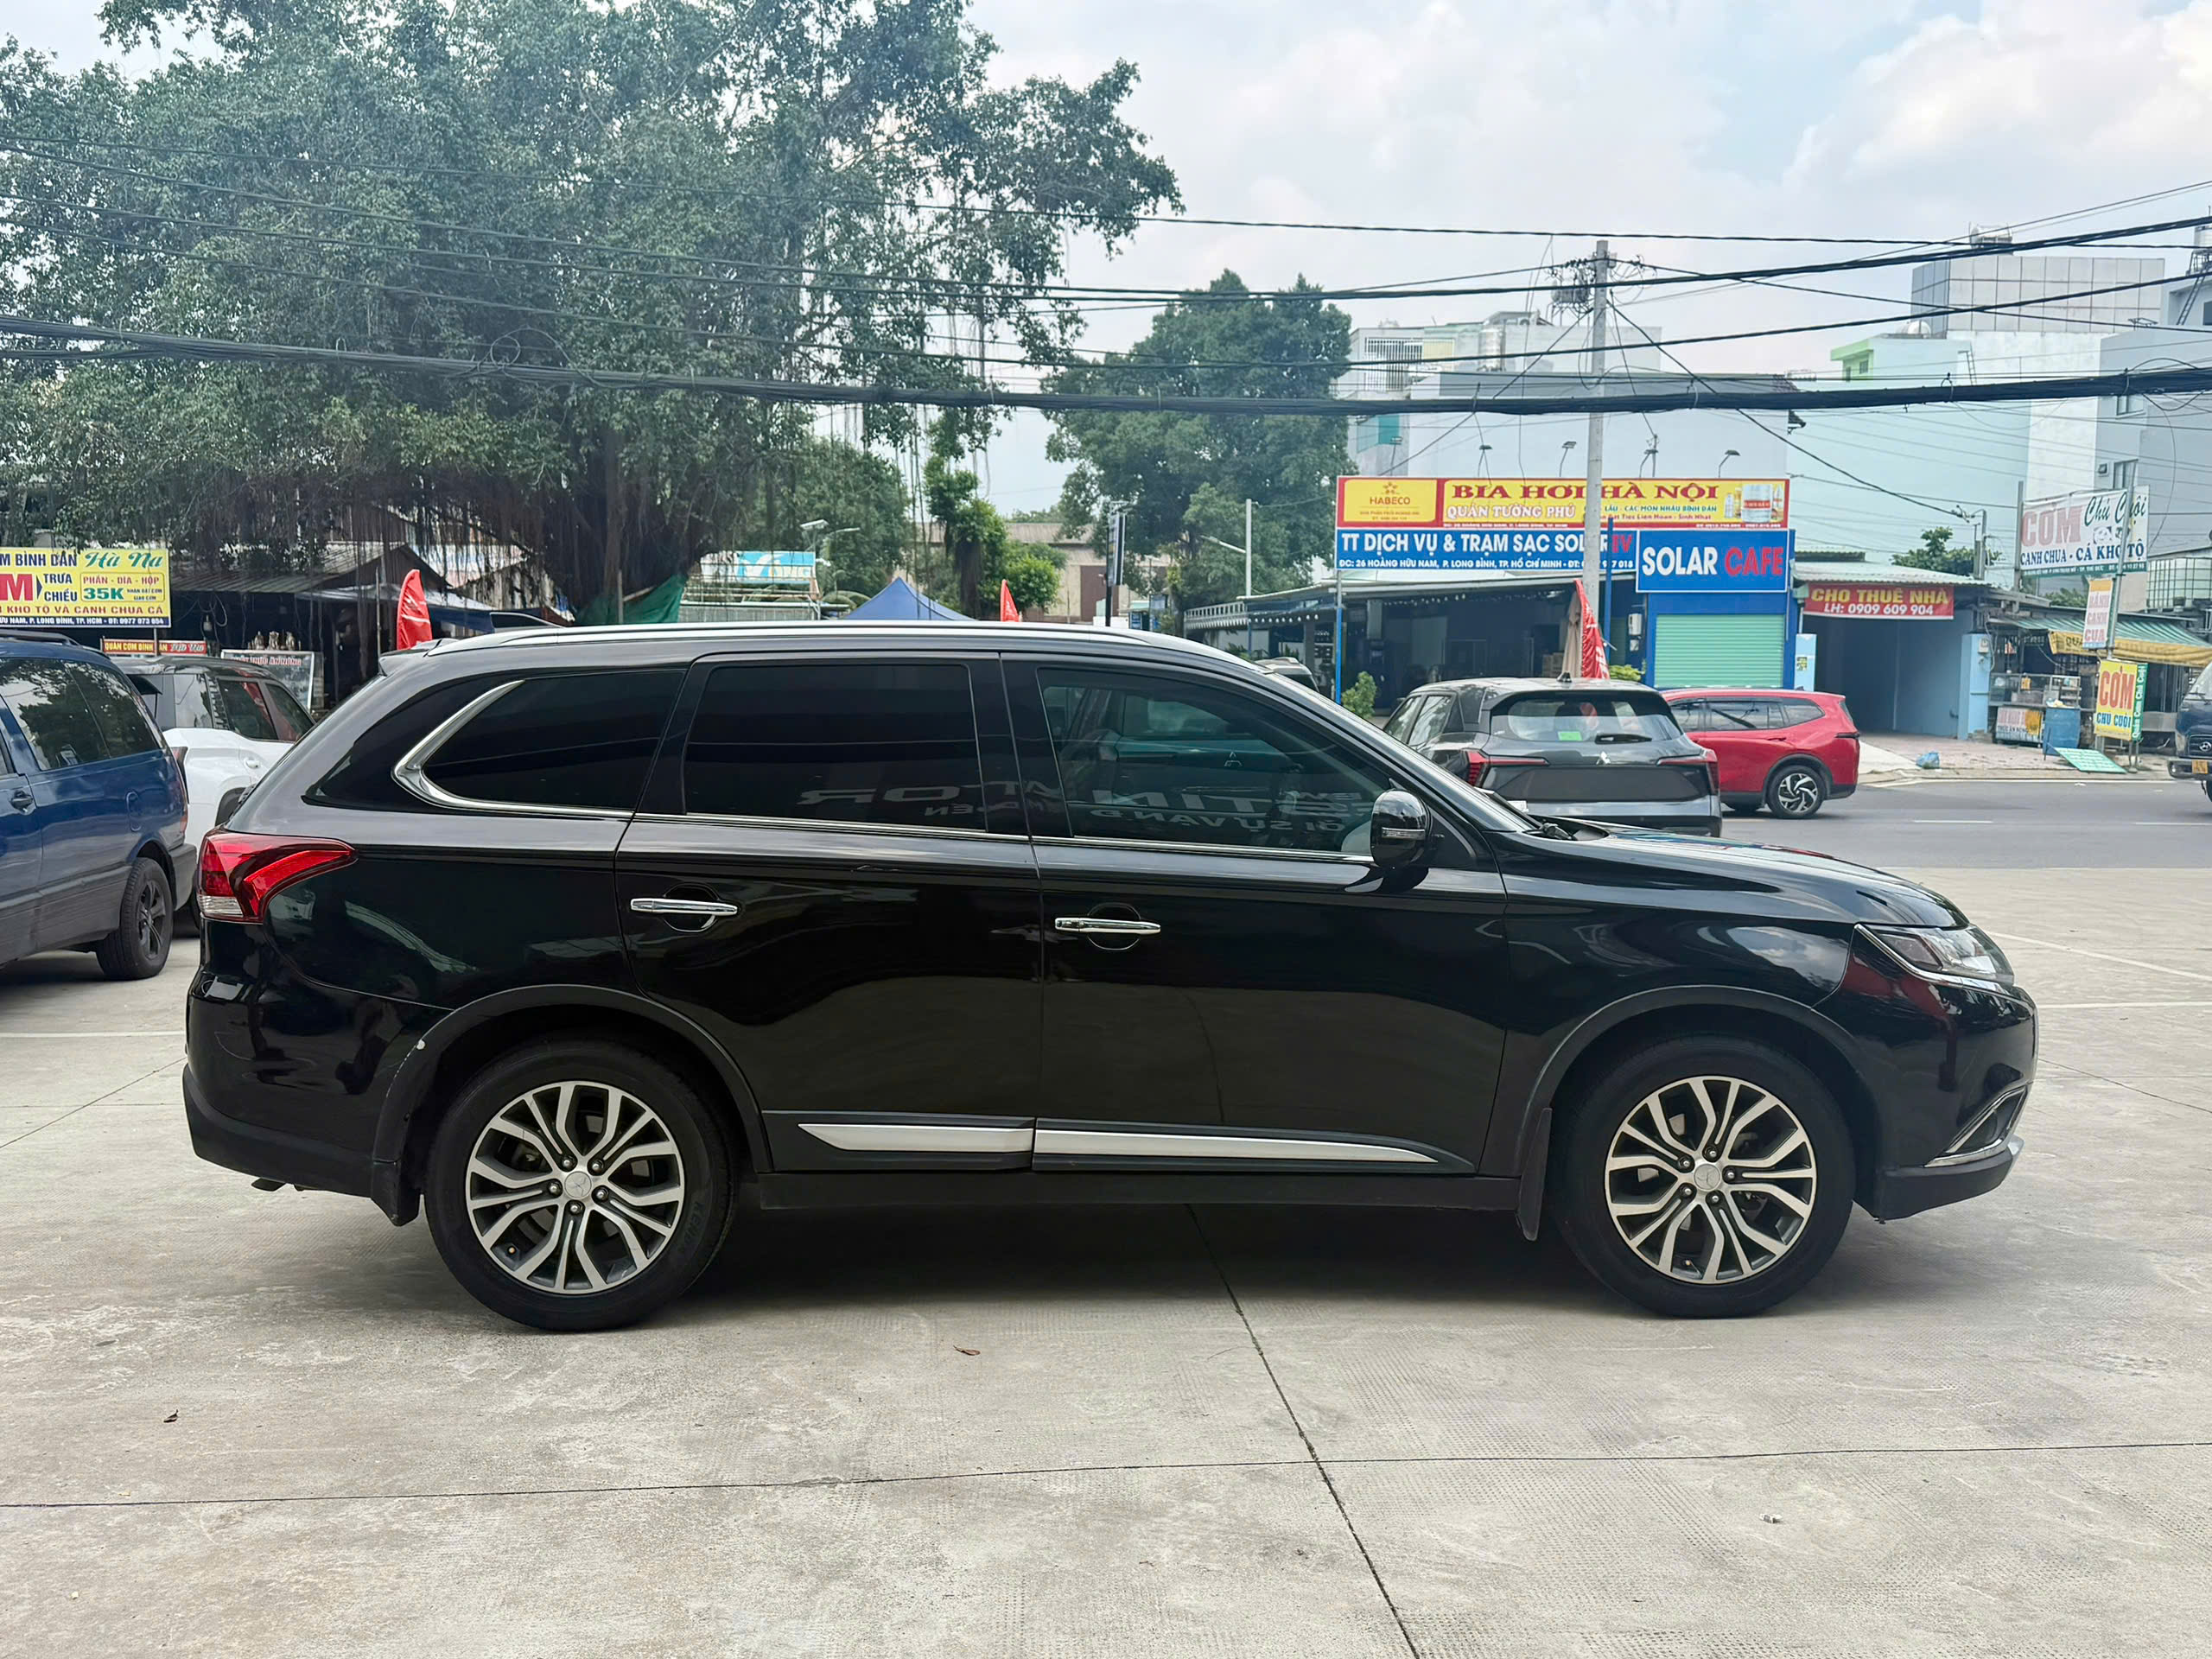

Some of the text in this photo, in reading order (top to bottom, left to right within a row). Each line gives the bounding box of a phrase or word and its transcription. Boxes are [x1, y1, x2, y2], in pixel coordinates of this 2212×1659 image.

[1452, 482, 1719, 502] BIA HƠI HÀ NỘI
[1446, 503, 1489, 519] QUÁN
[1547, 504, 1576, 518] PHÚ
[1342, 533, 1360, 551] TT
[1364, 533, 1408, 556] DỊCH
[1414, 533, 1438, 556] VỤ
[1443, 534, 1456, 552] &
[1460, 534, 1509, 556] TRẠM
[1513, 534, 1550, 556] SẠC
[1554, 534, 1608, 552] SOLR
[2020, 551, 2043, 565] CANH
[2044, 549, 2067, 563] CHUA
[2076, 543, 2093, 561] CÁ
[2127, 539, 2145, 561] TỘ
[16, 550, 46, 566] BÌNH
[50, 550, 78, 567] DÂN
[85, 552, 121, 569] Hà
[1368, 556, 1398, 567] HOÀNG
[1476, 557, 1497, 569] BÌNH,
[1511, 557, 1522, 568] HỒ
[1524, 557, 1540, 568] CHÍ
[1642, 546, 1783, 576] SOLAR CAFE
[43, 573, 73, 584] TRƯA
[141, 575, 160, 586] HỘP
[84, 588, 124, 600] 35K
[1811, 588, 1948, 604] CHO THUÊ NHÀ
[54, 605, 69, 613] VÀ
[148, 605, 163, 613] CÁ
[1824, 603, 1934, 615] LH: 0909 609 904
[2084, 629, 2105, 641] CUA
[2100, 665, 2134, 710] CƠM
